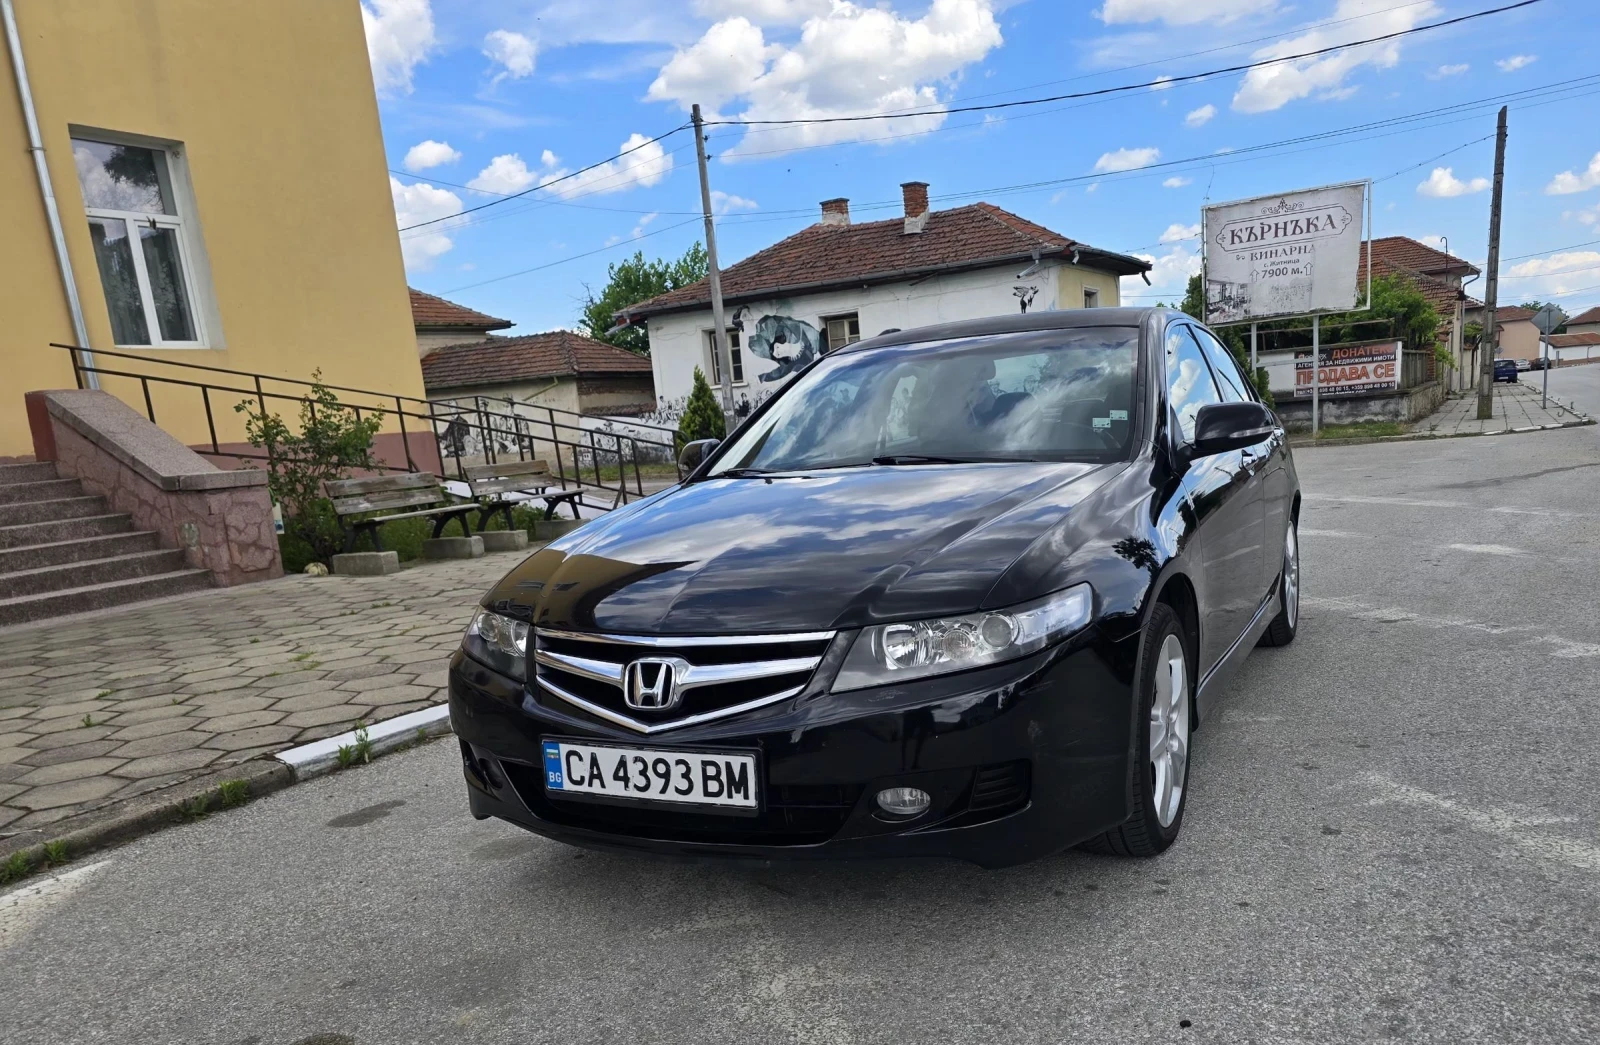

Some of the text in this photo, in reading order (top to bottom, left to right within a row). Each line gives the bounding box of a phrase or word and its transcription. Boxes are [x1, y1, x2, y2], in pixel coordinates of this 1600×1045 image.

[1229, 213, 1337, 246] КЪРНЪКА
[1261, 266, 1288, 279] 7900
[1334, 356, 1373, 365] НЕДВИЖИМИ
[1373, 354, 1395, 362] ИМОТИ
[1373, 363, 1395, 378] СЕ
[548, 771, 562, 783] BG
[565, 749, 750, 800] CA 4393 BM
